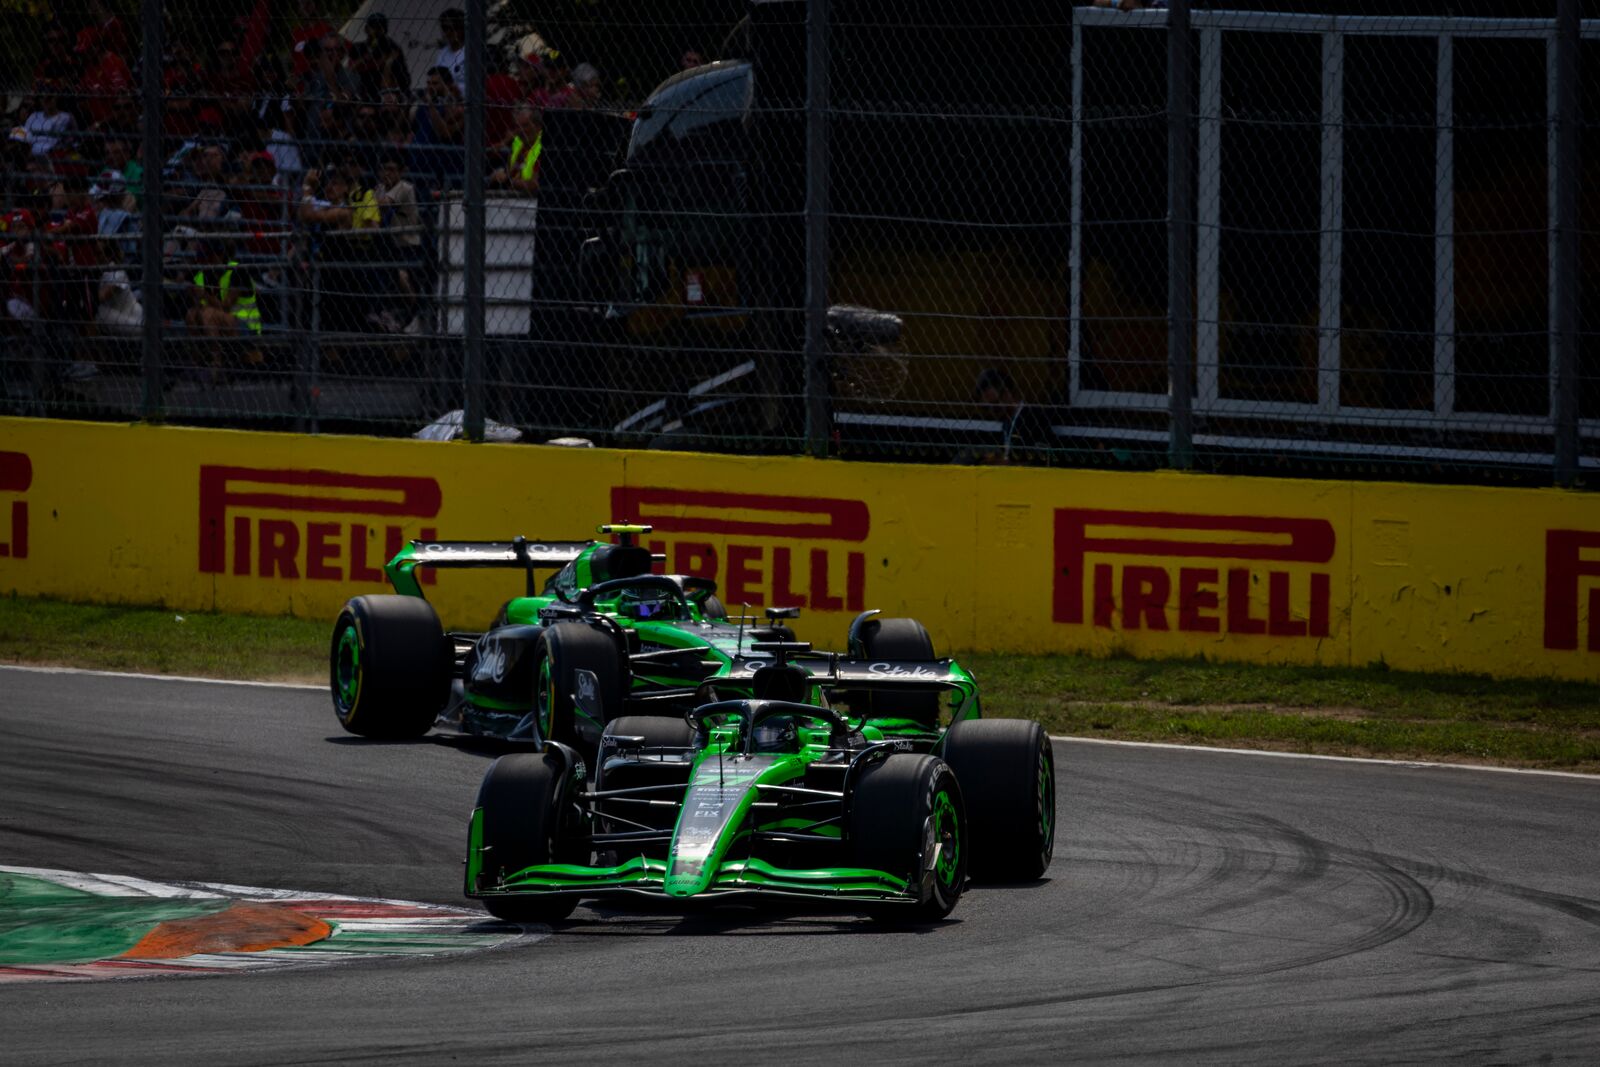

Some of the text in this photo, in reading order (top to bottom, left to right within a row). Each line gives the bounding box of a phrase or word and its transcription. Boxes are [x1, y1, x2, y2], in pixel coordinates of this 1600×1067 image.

[425, 543, 486, 558] Stk
[1053, 508, 1335, 637] PIRELLI
[868, 662, 937, 680] Stake
